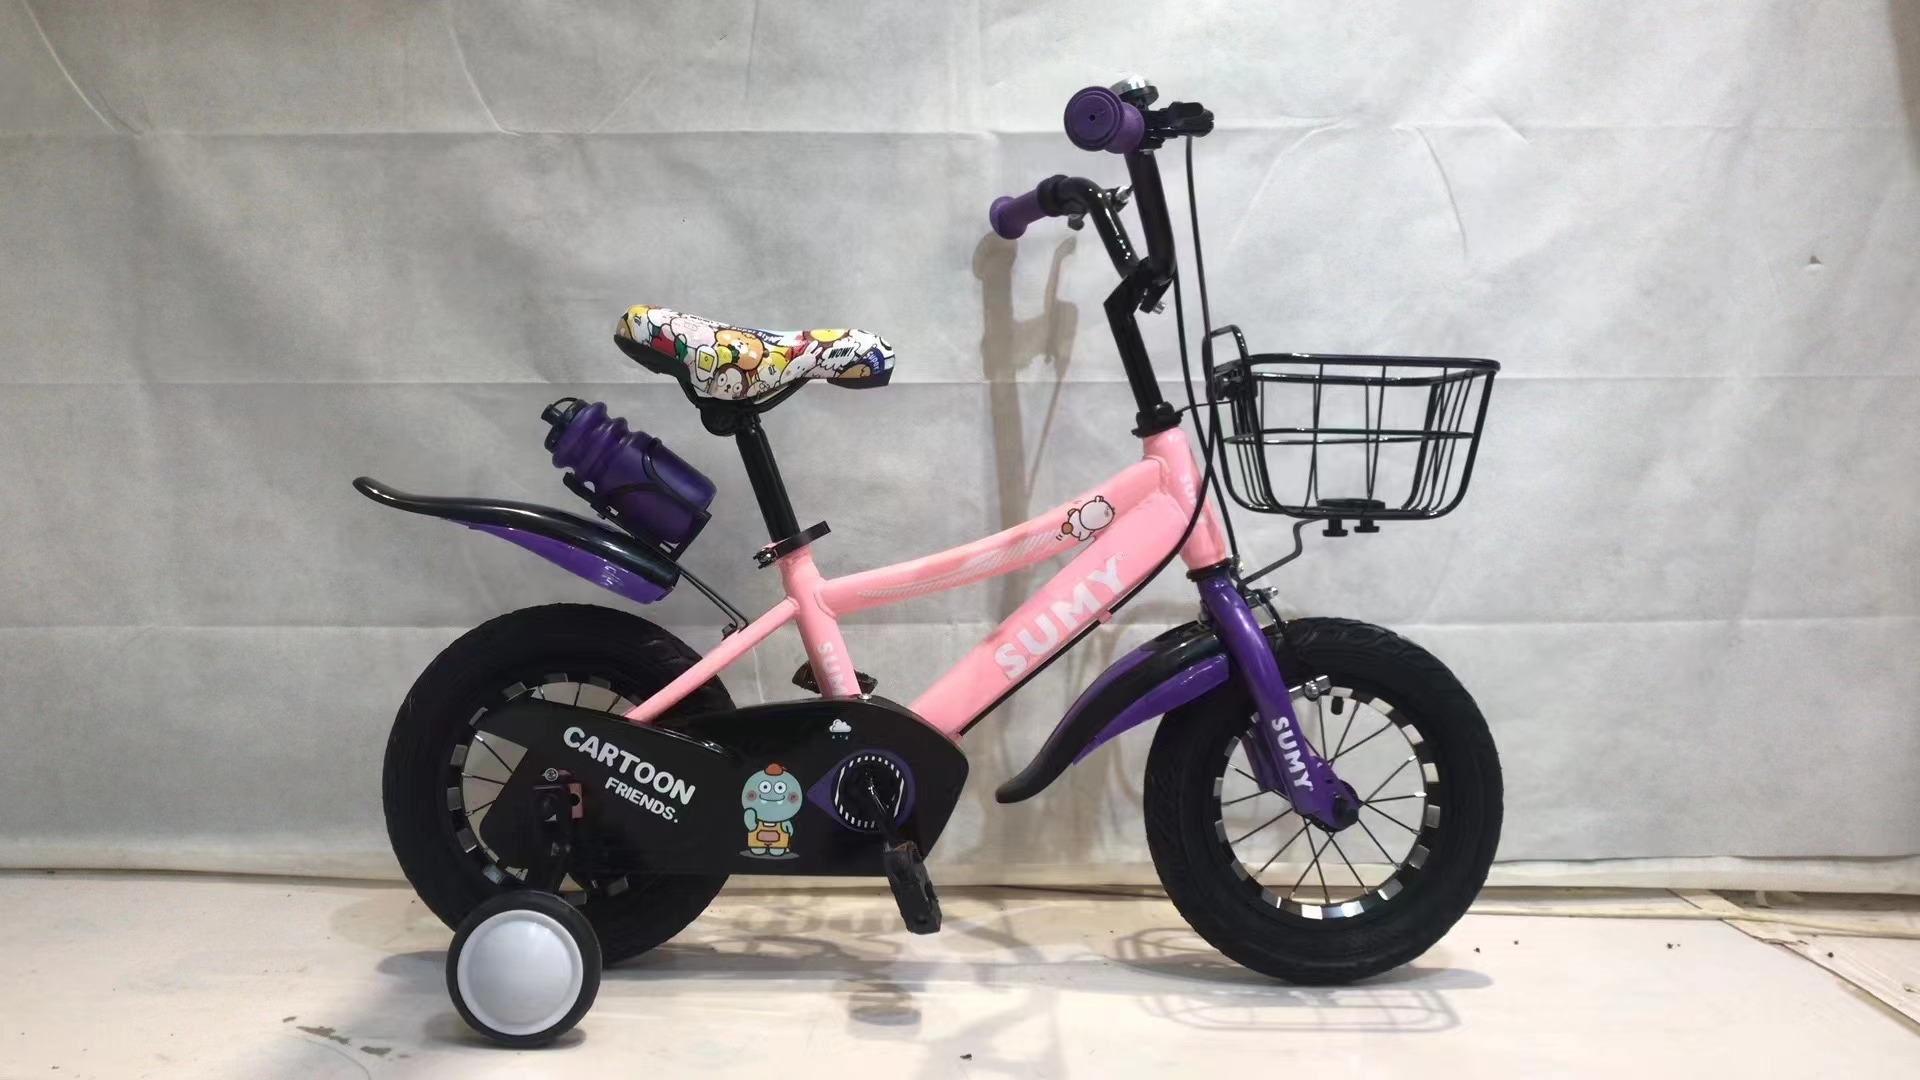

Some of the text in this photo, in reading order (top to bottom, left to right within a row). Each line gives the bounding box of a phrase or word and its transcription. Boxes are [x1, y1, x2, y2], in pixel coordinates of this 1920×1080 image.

[828, 346, 854, 359] WOW!
[994, 555, 1126, 680] SUMY
[563, 726, 696, 805] CARTOON
[1271, 716, 1313, 790] SUMY
[605, 776, 678, 824] FRIENDS.
